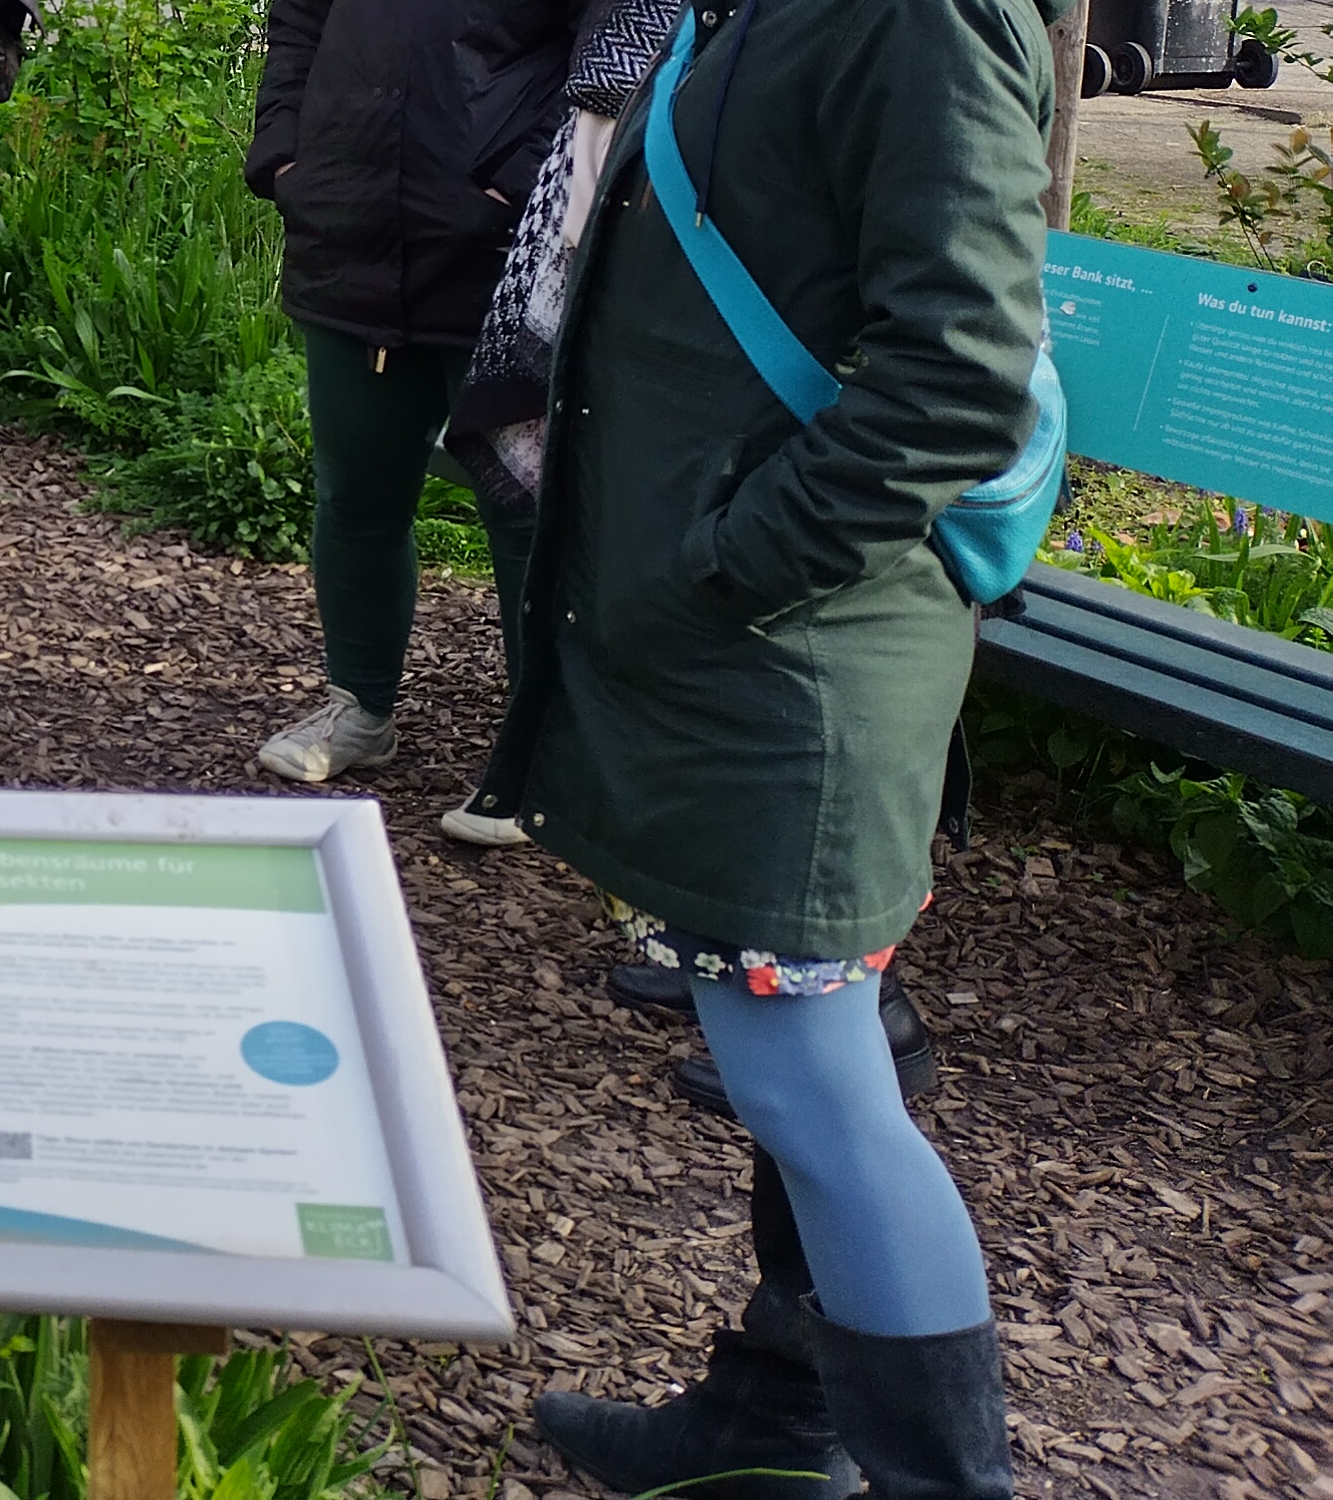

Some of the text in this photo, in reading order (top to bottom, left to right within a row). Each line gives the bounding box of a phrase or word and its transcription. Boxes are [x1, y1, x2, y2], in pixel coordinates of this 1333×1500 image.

[1071, 266, 1104, 284] Bank
[1104, 273, 1136, 292] sitzt,
[1198, 292, 1332, 333] Was du tun kannst:
[157, 856, 196, 875] für
